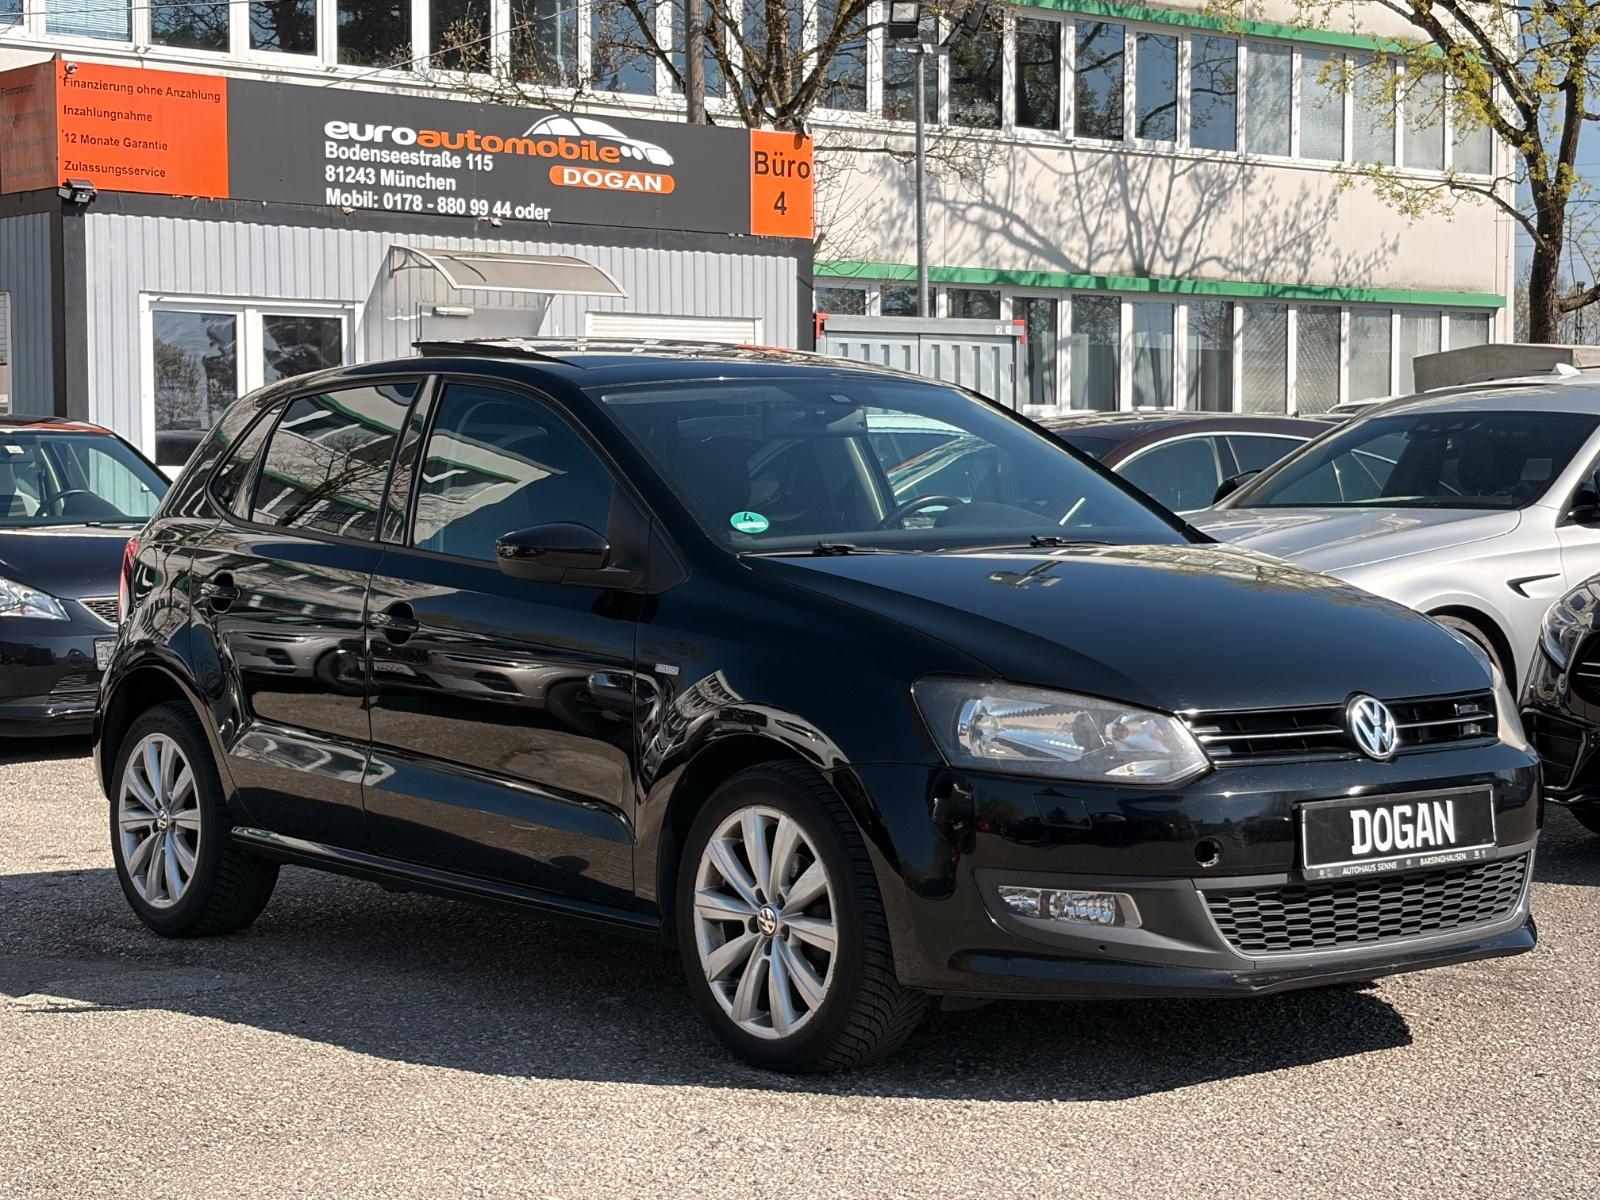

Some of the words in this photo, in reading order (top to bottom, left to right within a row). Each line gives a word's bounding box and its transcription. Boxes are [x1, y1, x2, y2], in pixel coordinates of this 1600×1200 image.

[63, 77, 134, 95] Finanzierung
[136, 85, 163, 97] ohne
[165, 86, 221, 103] Anzahlung
[63, 104, 153, 122] Inzahlungnahme
[64, 132, 77, 144] 12
[80, 134, 120, 147] Monate
[123, 138, 168, 151] Garantie
[325, 141, 461, 169] Bodenseestraße
[466, 153, 493, 171] 115
[754, 151, 811, 179] Büro
[64, 160, 166, 178] Zulassungsservice
[325, 165, 375, 184] 81243
[380, 169, 456, 191] München
[563, 168, 662, 192] DOGAN
[325, 188, 379, 209] Mobil:
[383, 192, 423, 212] 0178
[436, 196, 466, 215] 880
[470, 199, 489, 217] 99
[492, 200, 511, 218] 44
[514, 203, 551, 221] oder
[773, 191, 787, 216] 4
[743, 512, 754, 522] 4
[1350, 800, 1456, 855] DOGAN
[1342, 865, 1376, 876] AUTOHAUS
[1377, 861, 1398, 871] SENNE
[1419, 852, 1467, 866] BARSINGHAUSEN
